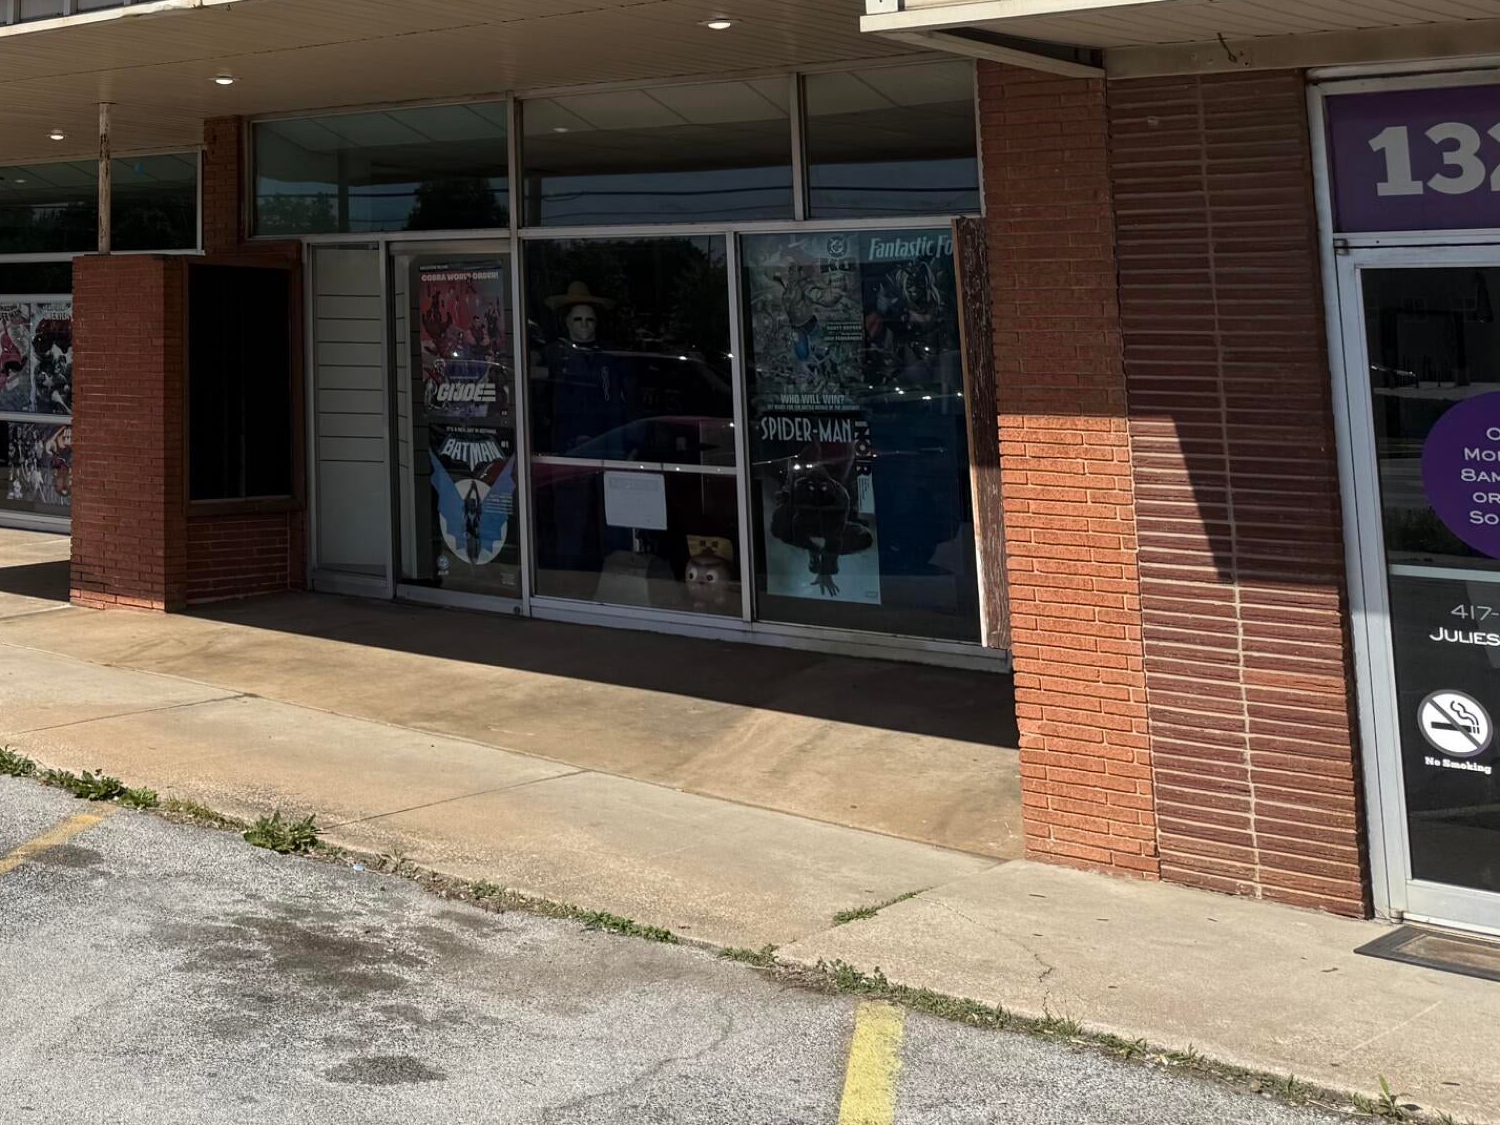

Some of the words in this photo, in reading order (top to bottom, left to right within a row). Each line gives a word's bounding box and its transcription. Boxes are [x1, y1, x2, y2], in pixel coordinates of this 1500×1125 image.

[868, 236, 935, 261] Fantastic
[421, 274, 446, 282] COBRA
[780, 394, 800, 404] WHO
[801, 394, 821, 404] WILL
[822, 394, 845, 404] WIN?
[761, 416, 852, 444] SPIDER-MAN
[441, 438, 504, 472] BATMAN
[1424, 756, 1441, 768] No
[1442, 759, 1492, 775] Smoking
